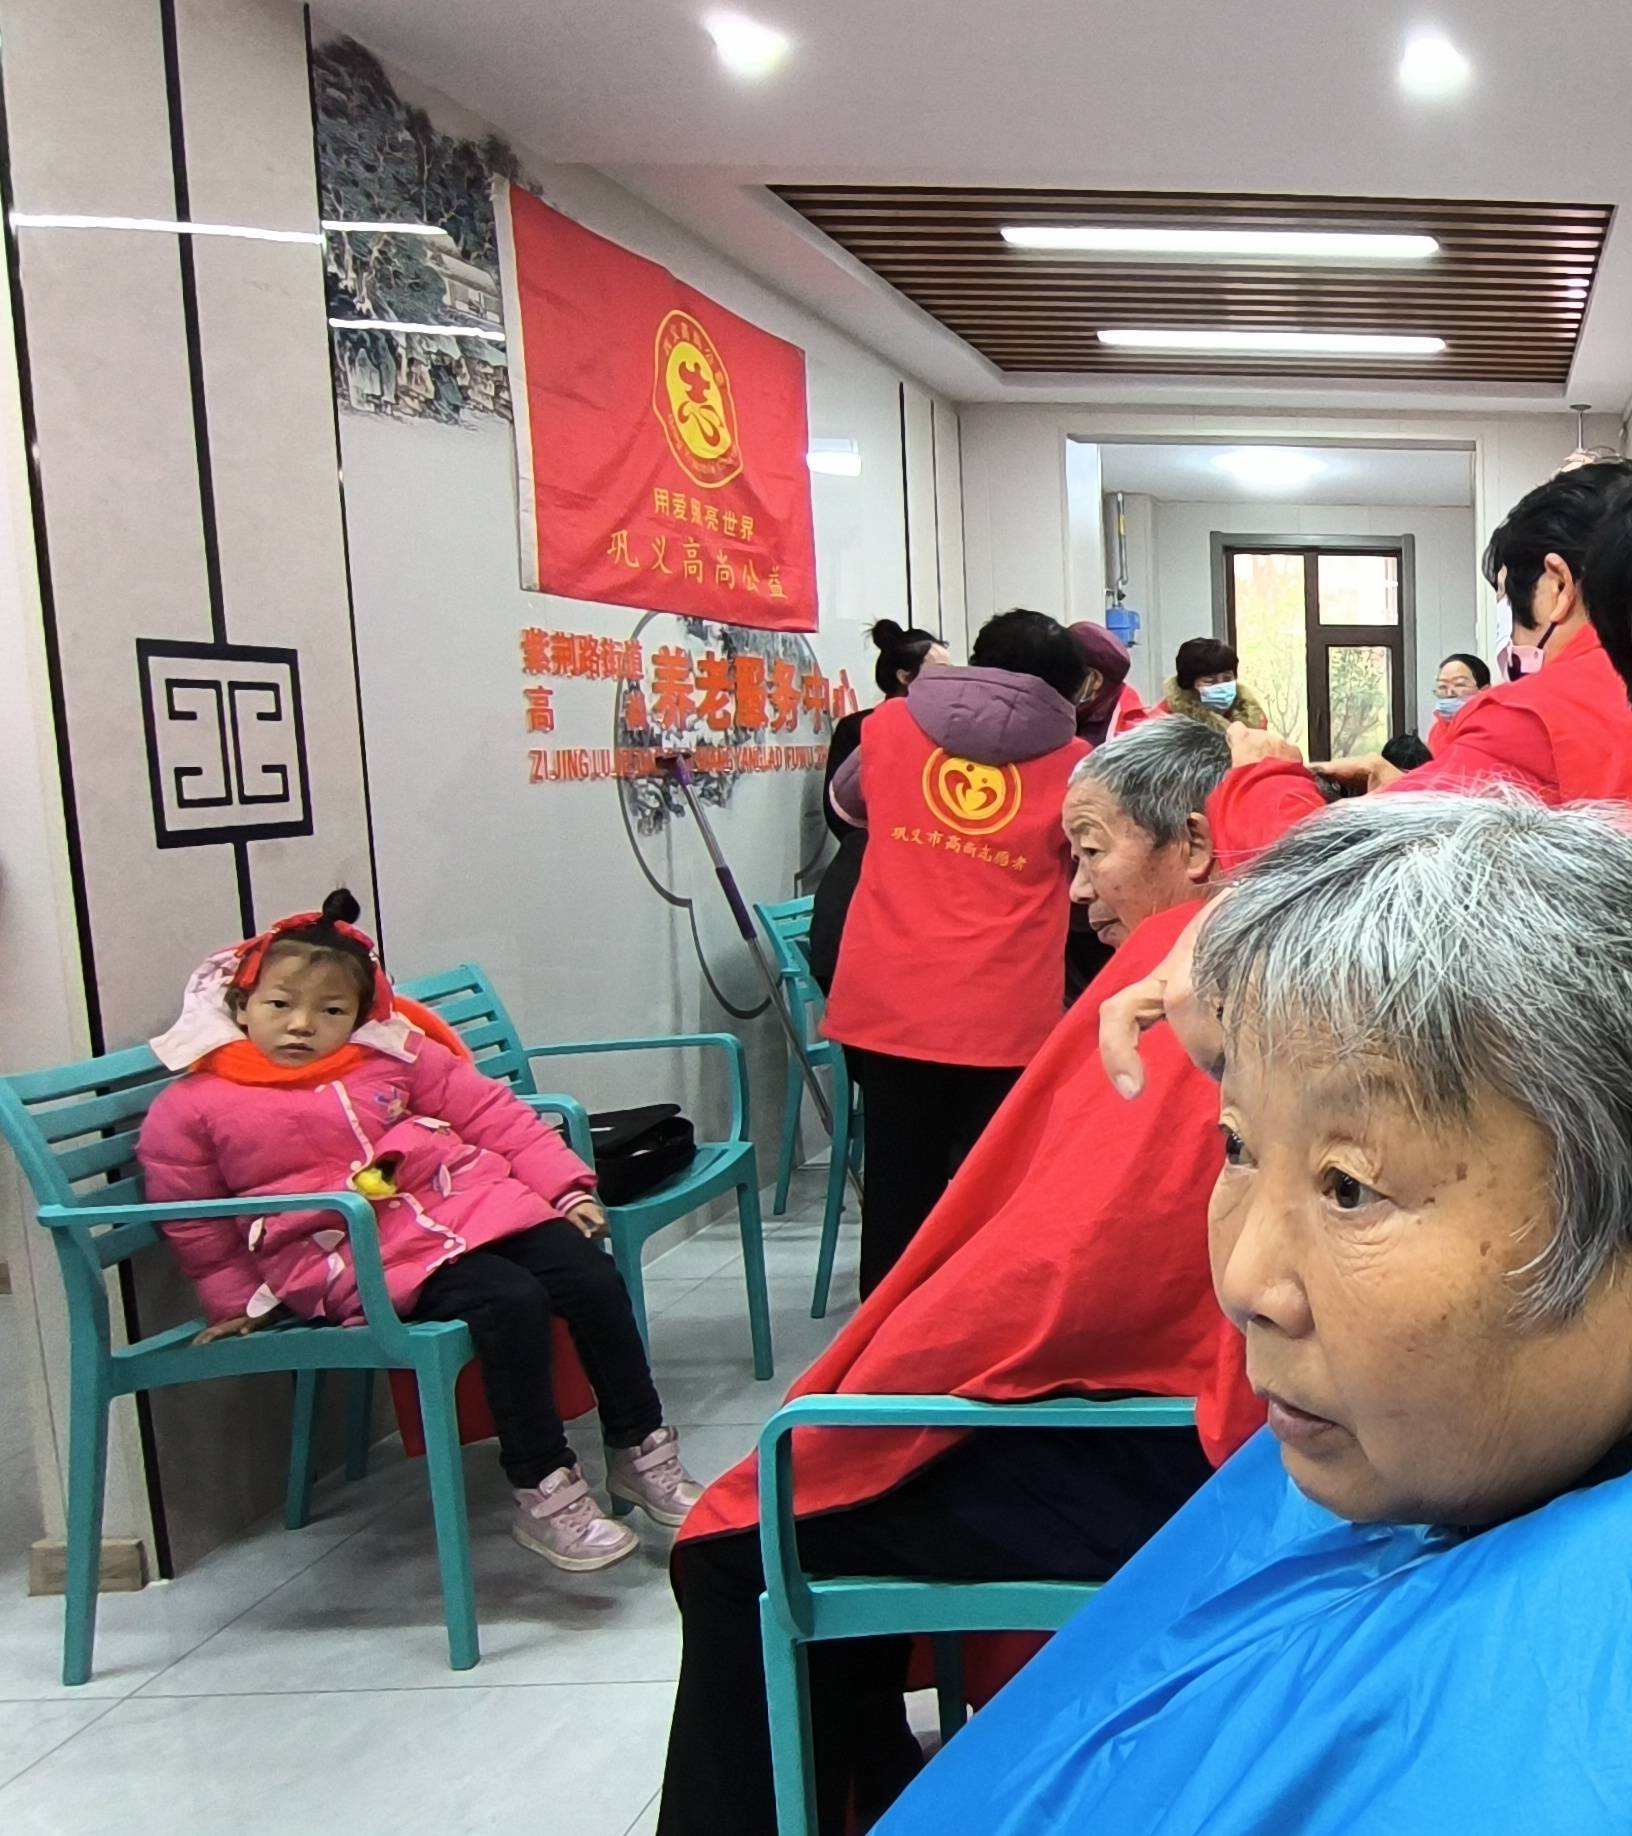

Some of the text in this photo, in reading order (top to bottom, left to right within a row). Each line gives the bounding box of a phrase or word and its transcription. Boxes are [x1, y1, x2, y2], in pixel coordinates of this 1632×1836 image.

[606, 529, 789, 601] 巩义高尚公益
